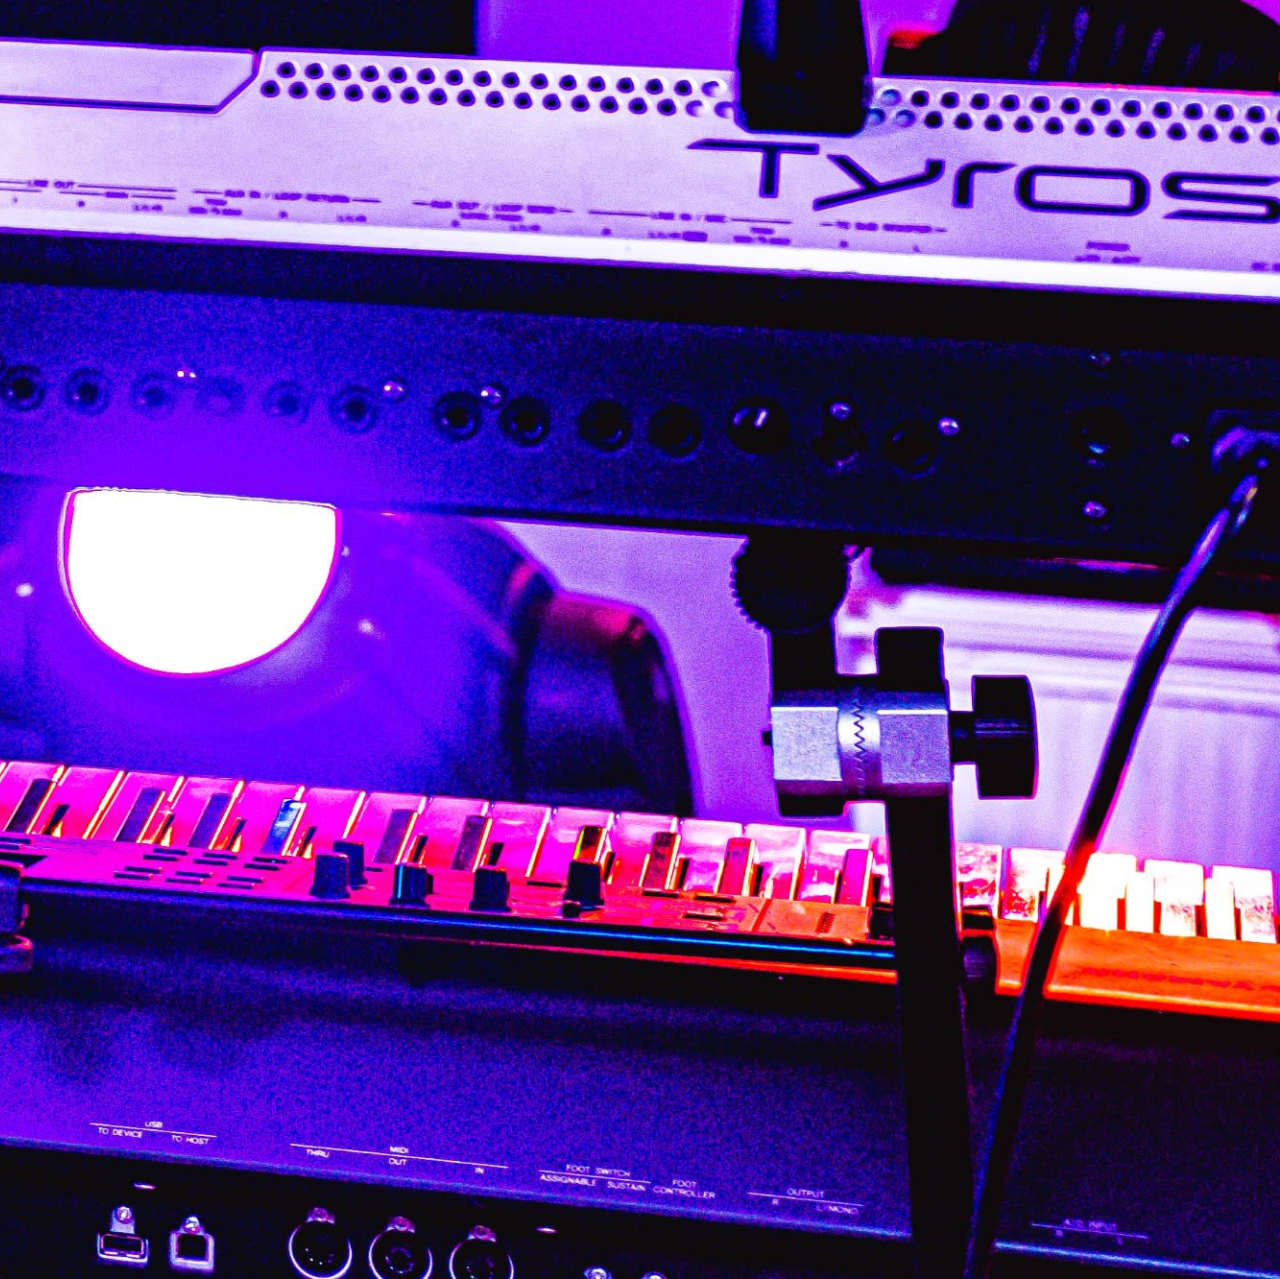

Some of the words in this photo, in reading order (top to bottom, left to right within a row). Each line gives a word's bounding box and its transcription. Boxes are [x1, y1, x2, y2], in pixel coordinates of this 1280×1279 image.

[686, 138, 1280, 224] Tyros
[98, 1127, 109, 1135] TO
[112, 1129, 142, 1139] DEVICE
[172, 1134, 182, 1142] TO
[186, 1136, 209, 1145] HOST
[306, 1149, 330, 1158] THRU
[389, 1146, 409, 1154] MIDI
[389, 1158, 407, 1166] OUT
[566, 1164, 590, 1173] FOOT
[596, 1167, 631, 1177] SWITCH
[540, 1174, 596, 1187] ASSIGNABLE
[672, 1179, 697, 1188] FOOT
[607, 1181, 646, 1192] SUSTAIN
[653, 1185, 716, 1199] CONTROLLER
[787, 1187, 824, 1198] OUTPUT
